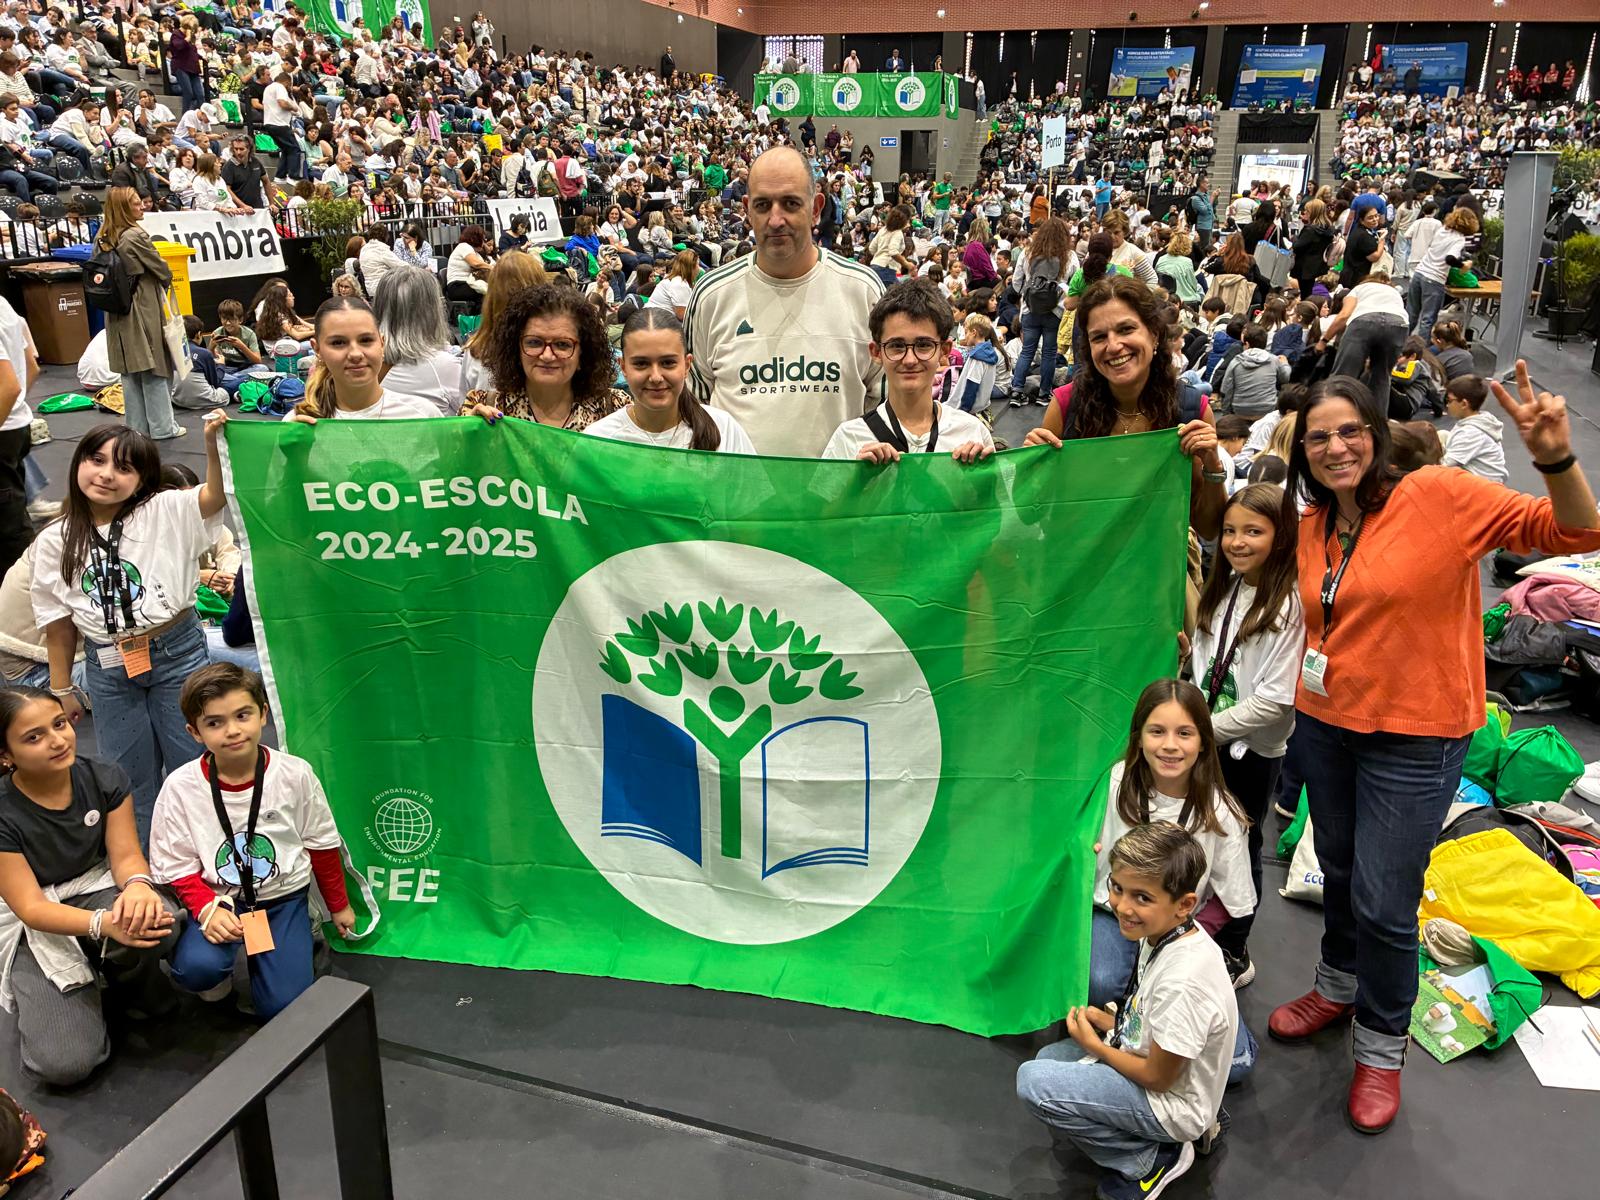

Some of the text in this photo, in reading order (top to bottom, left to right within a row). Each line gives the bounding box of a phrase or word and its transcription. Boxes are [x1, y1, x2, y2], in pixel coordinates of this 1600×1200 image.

[1046, 135, 1062, 149] Porto
[150, 221, 279, 263] imbra
[740, 355, 840, 385] adidas
[740, 385, 840, 395] SPORTSWEAR
[303, 475, 589, 525] ECO-ESCOLA
[316, 526, 538, 560] 2024-2025
[372, 788, 434, 804] FOUNDATION FOR
[414, 828, 442, 860] EDUCATION
[367, 866, 440, 902] FEE
